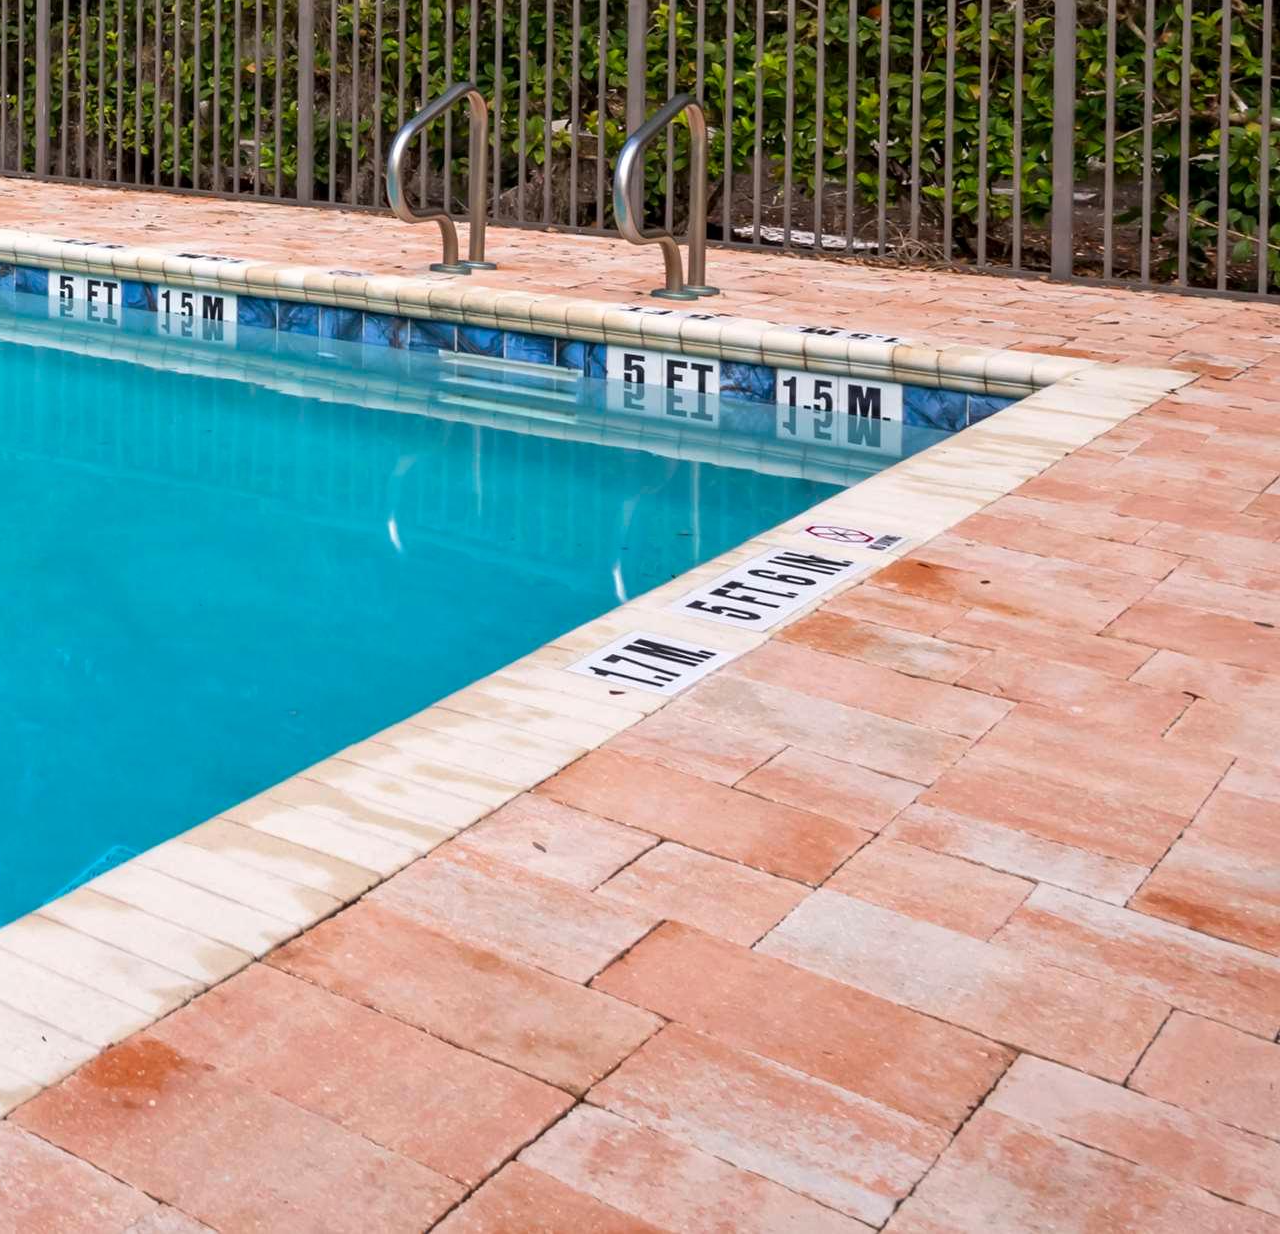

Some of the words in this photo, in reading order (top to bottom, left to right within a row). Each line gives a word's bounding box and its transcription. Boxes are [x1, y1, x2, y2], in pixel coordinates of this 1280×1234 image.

[60, 275, 73, 298] 5
[87, 279, 118, 305] FT
[624, 353, 645, 384] 5
[666, 359, 713, 394] FT
[783, 376, 833, 413] 1.5
[685, 600, 761, 621] 5
[748, 569, 817, 586] 6
[590, 654, 681, 687] 1.7
